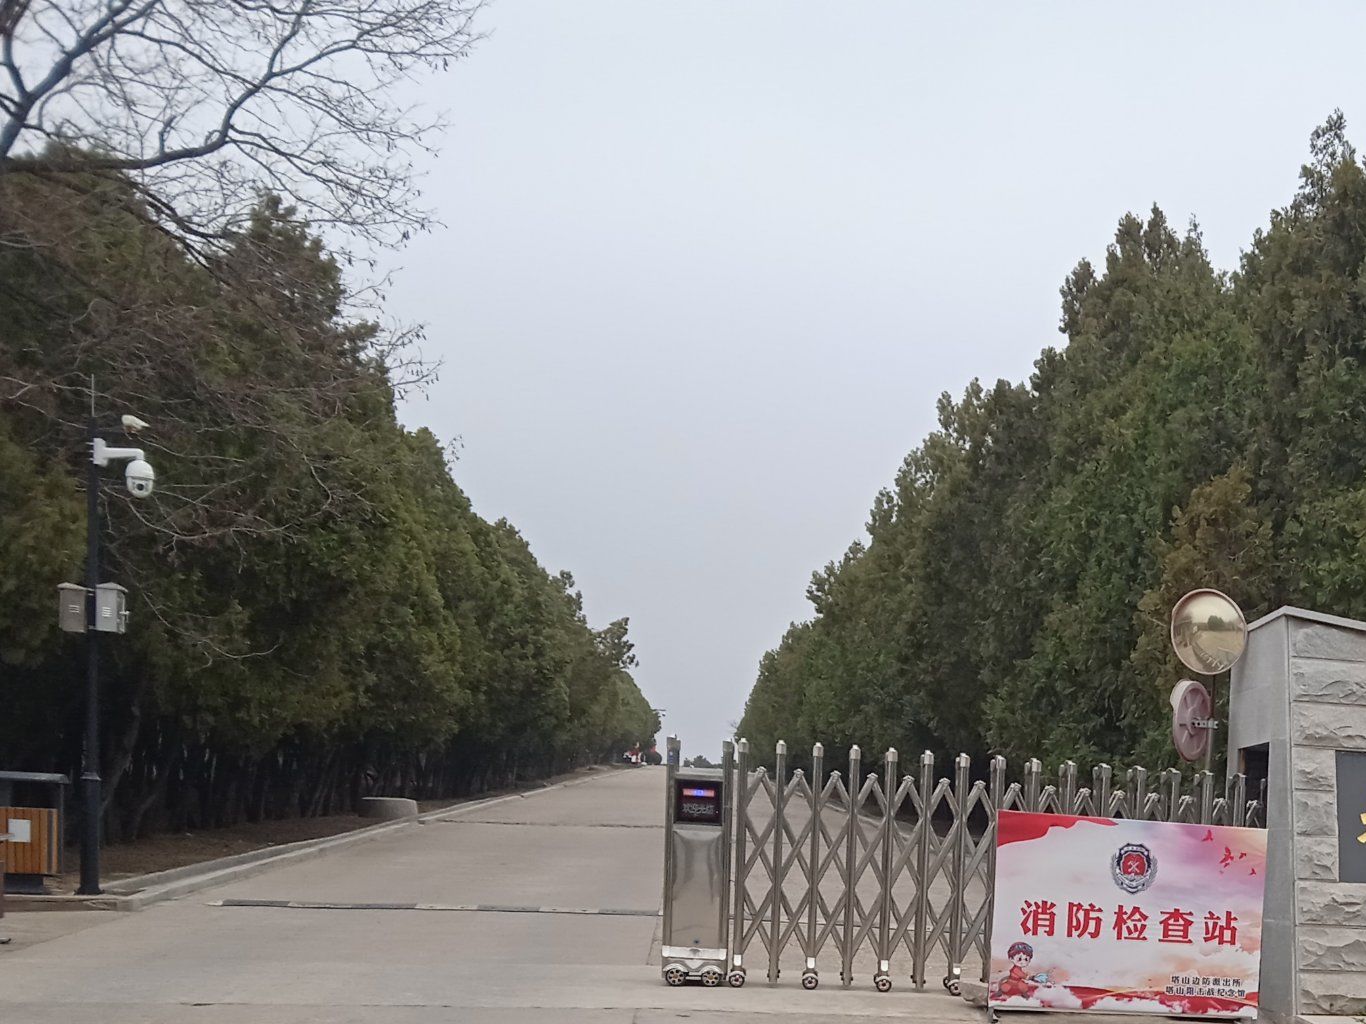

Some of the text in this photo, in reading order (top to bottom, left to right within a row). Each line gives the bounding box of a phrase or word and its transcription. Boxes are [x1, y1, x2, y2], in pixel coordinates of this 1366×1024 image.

[1020, 899, 1239, 946] 消防检查站
